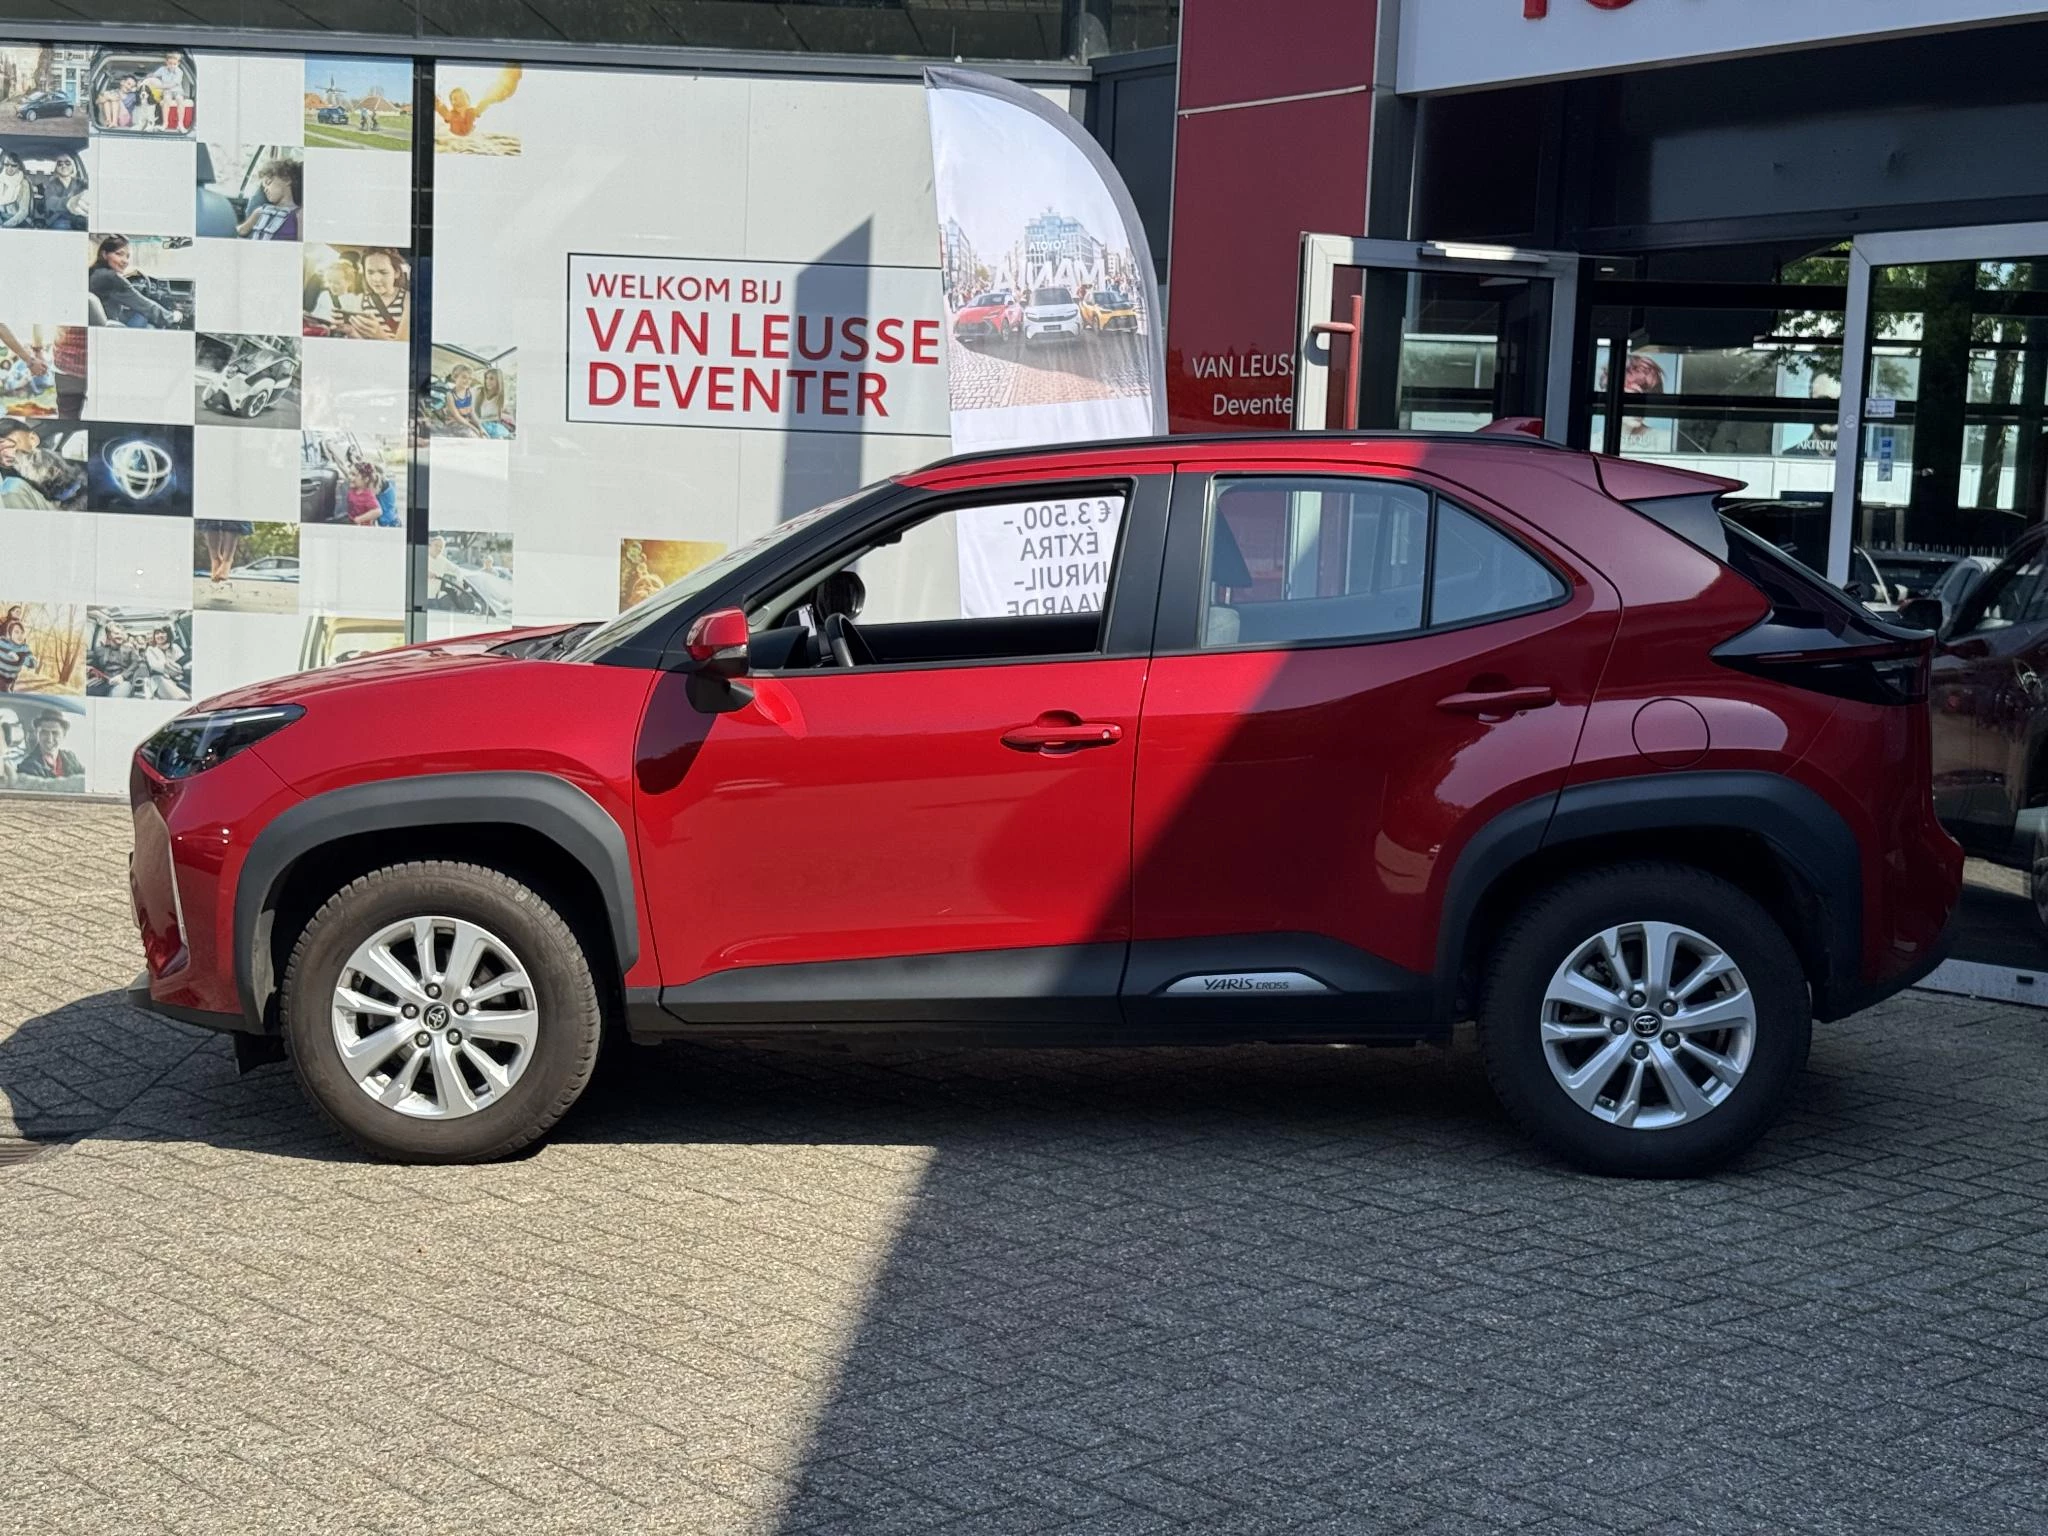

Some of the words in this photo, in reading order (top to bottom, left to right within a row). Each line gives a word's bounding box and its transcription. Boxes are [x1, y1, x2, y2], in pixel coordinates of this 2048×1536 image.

[586, 273, 731, 303] WELKOM
[741, 279, 783, 304] BIJ
[586, 307, 709, 356] VAN
[731, 313, 940, 365] LEUSSE
[1192, 356, 1234, 379] VAN
[588, 362, 889, 418] DEVENTER
[1255, 981, 1289, 990] CROSS
